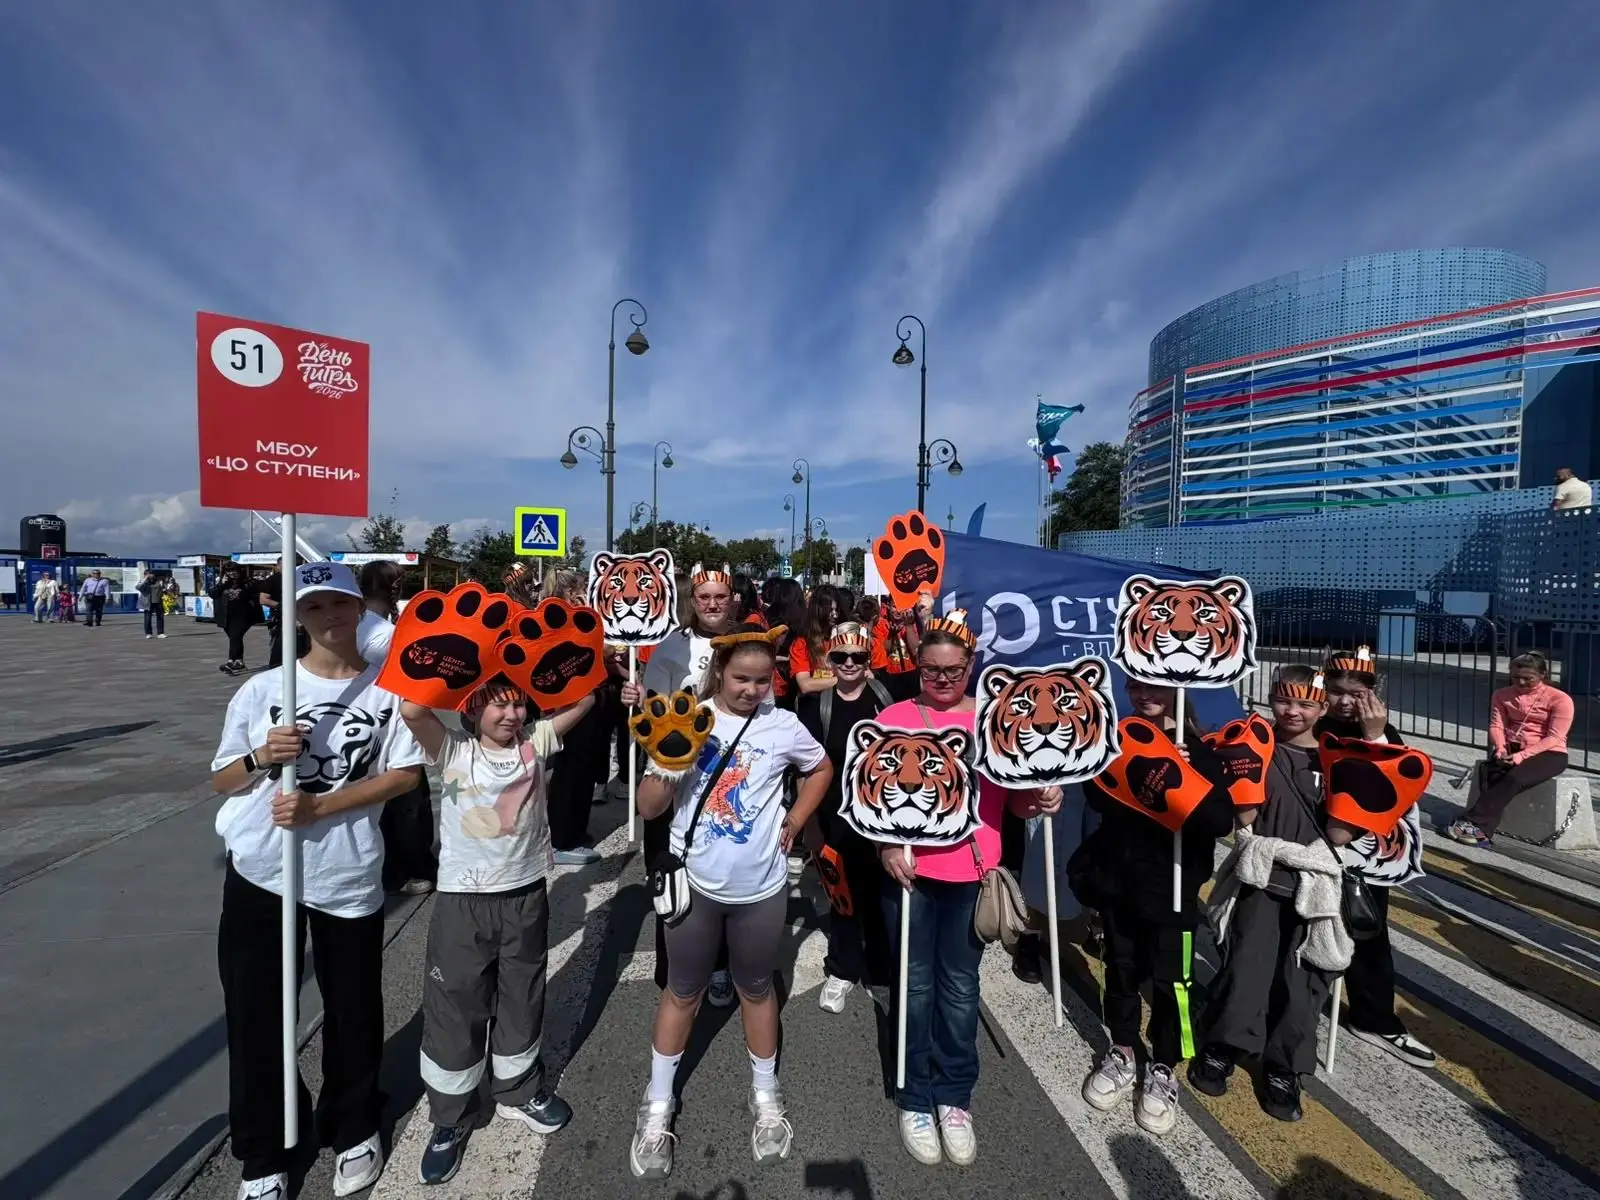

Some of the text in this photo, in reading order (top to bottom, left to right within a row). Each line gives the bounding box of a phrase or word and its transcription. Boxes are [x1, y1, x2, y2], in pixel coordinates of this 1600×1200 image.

[230, 339, 264, 374] 51
[297, 340, 353, 367] День
[315, 386, 344, 400] 2026
[256, 439, 318, 458] МБОУ
[206, 455, 361, 481] «ЦО СТУПЕНИ»
